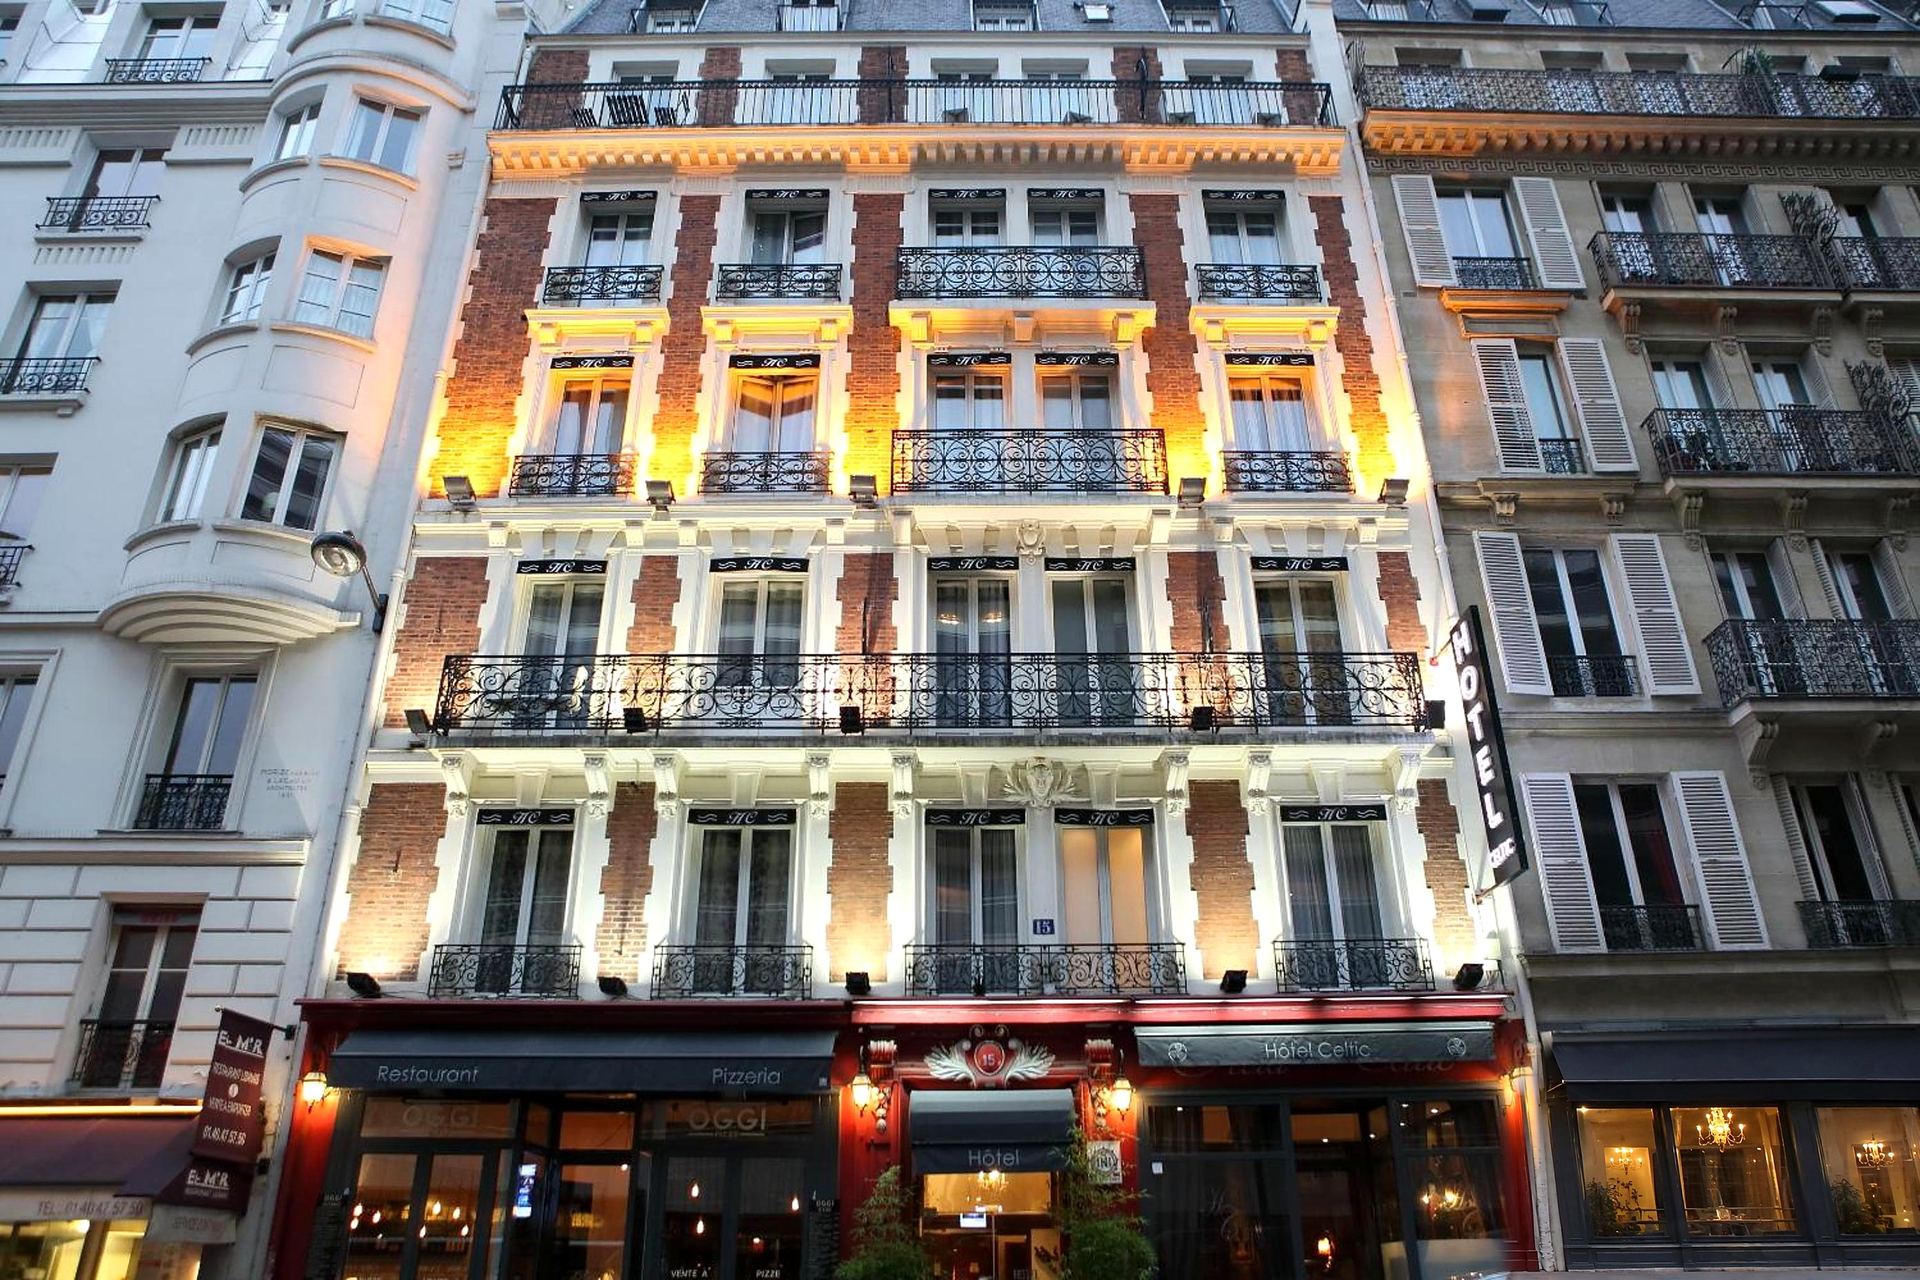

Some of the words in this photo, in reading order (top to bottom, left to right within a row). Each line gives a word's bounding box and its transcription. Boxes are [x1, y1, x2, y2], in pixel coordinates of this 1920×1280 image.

[1452, 620, 1504, 829] HOTEL
[1036, 920, 1051, 934] 15
[982, 1053, 996, 1067] 15
[1265, 1041, 1313, 1060] Hôtel
[1318, 1041, 1371, 1058] Celtic
[378, 1065, 479, 1082] Restaurant
[712, 1067, 780, 1084] Pizzeria
[403, 1105, 478, 1127] OGGI
[689, 1107, 767, 1131] OGGI
[968, 1148, 1020, 1167] Hôtel
